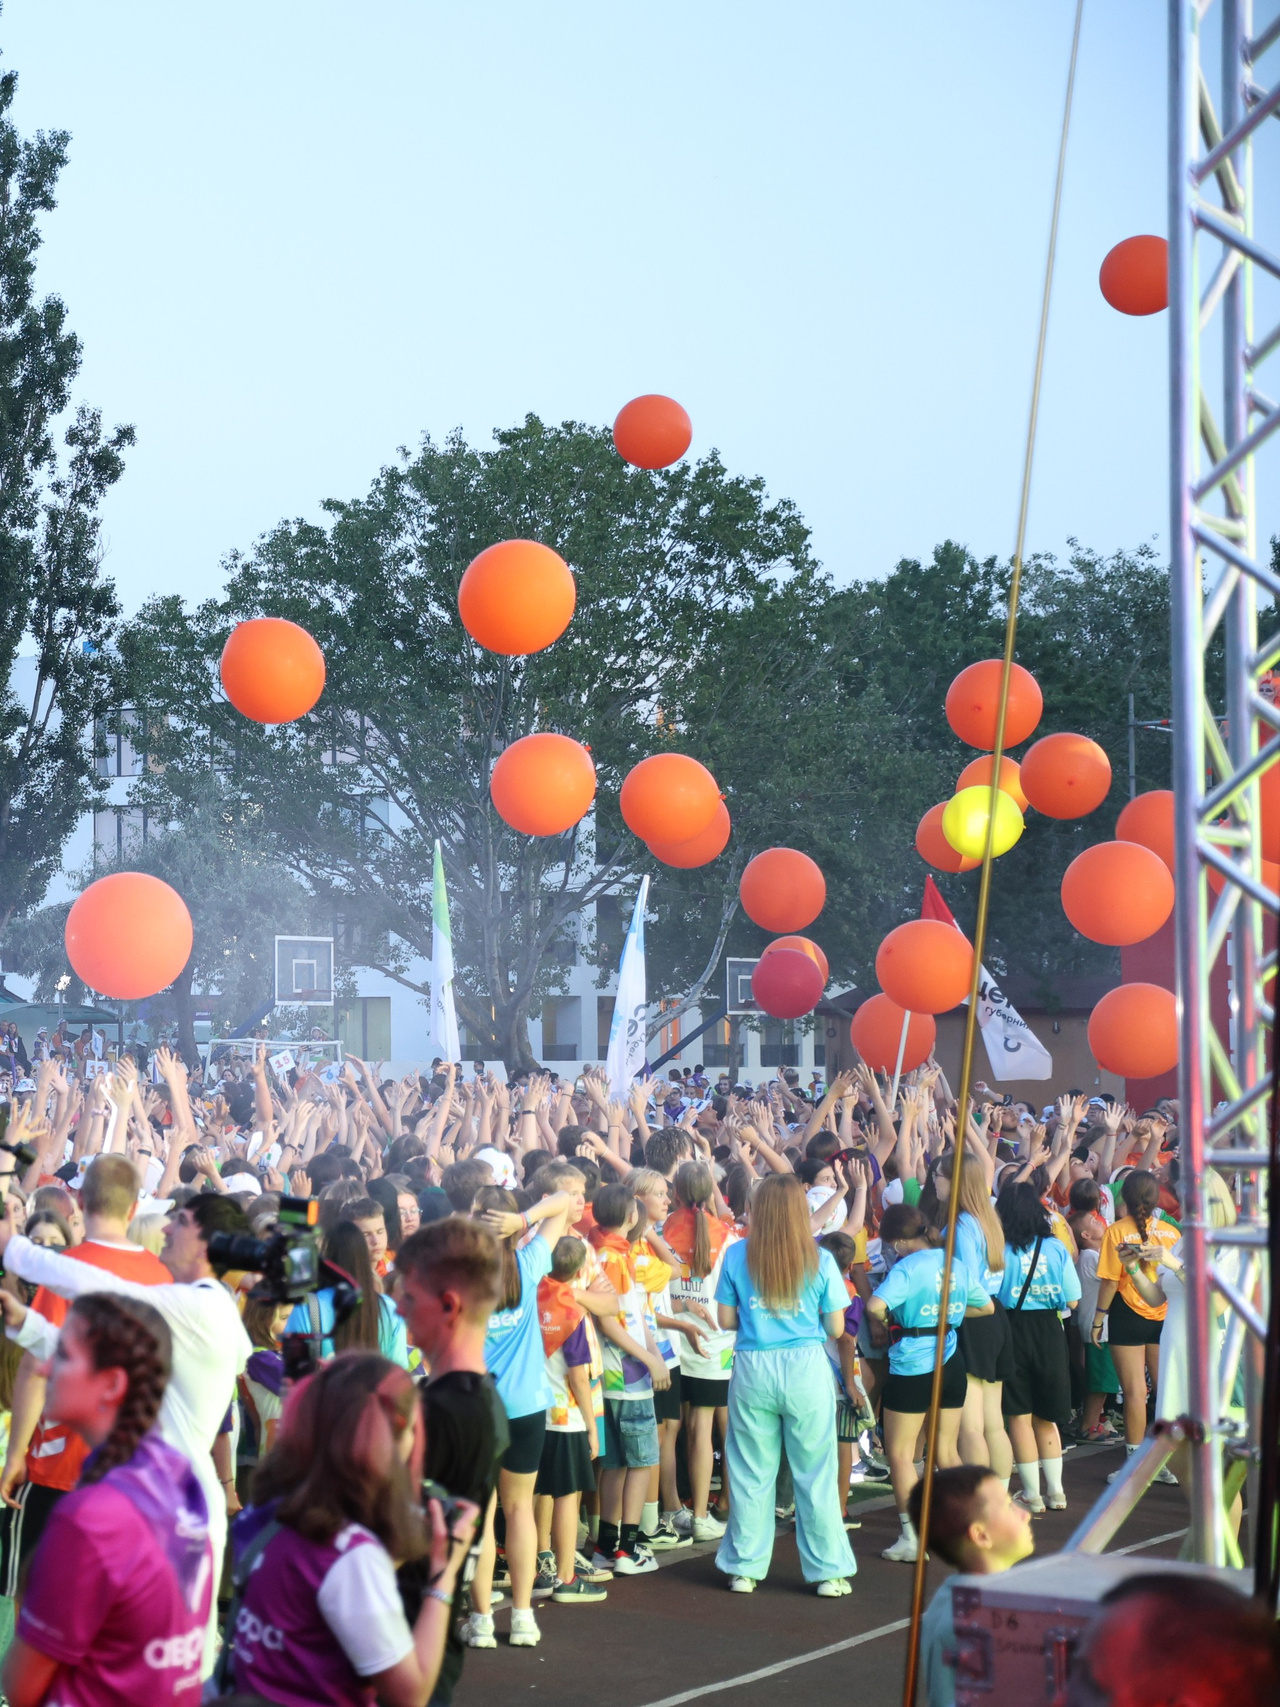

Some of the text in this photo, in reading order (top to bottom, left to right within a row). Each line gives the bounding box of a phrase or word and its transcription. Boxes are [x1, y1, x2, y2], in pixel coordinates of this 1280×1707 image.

[274, 1055, 290, 1069] 15
[325, 1068, 334, 1080] 6
[1011, 1284, 1061, 1299] свер
[920, 1301, 964, 1318] сеер
[143, 1626, 205, 1670] авр
